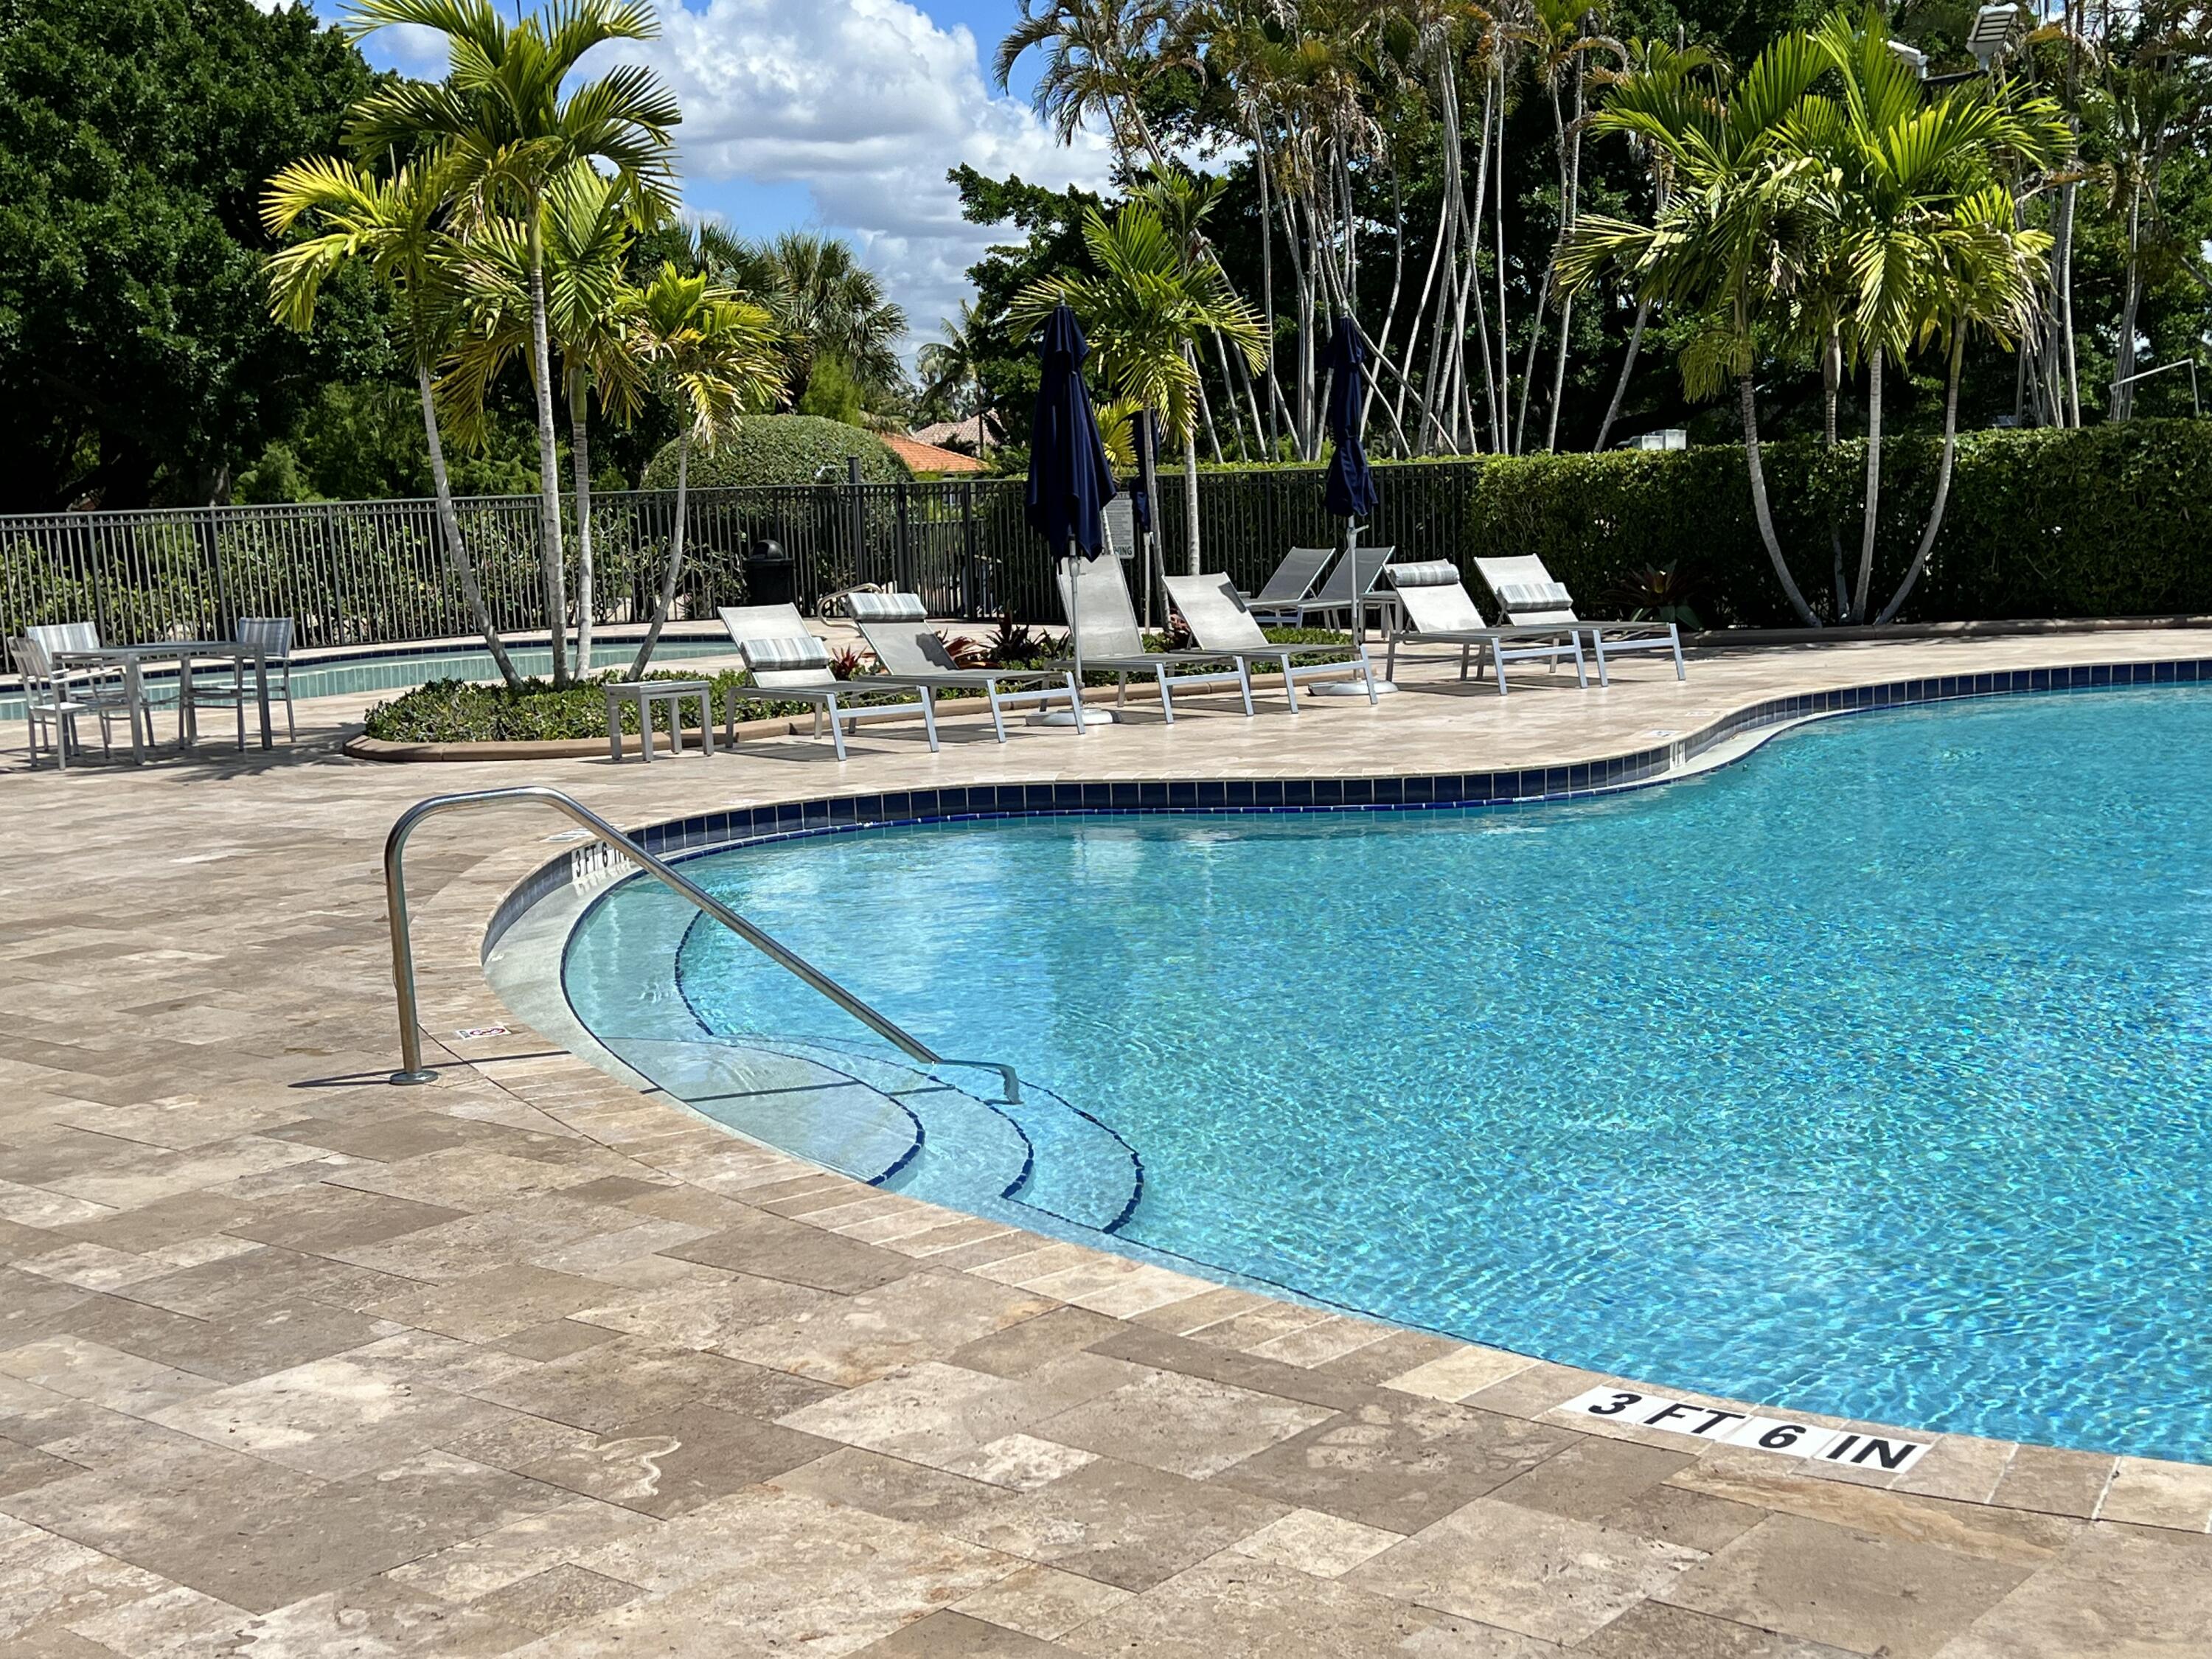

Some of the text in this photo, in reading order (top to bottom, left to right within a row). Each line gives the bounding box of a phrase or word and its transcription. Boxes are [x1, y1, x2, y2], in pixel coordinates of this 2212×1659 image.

[576, 850, 581, 877] 3
[584, 844, 597, 874] FT
[602, 841, 608, 868] 6
[1588, 1393, 1917, 1469] 3 FT 6 IN
